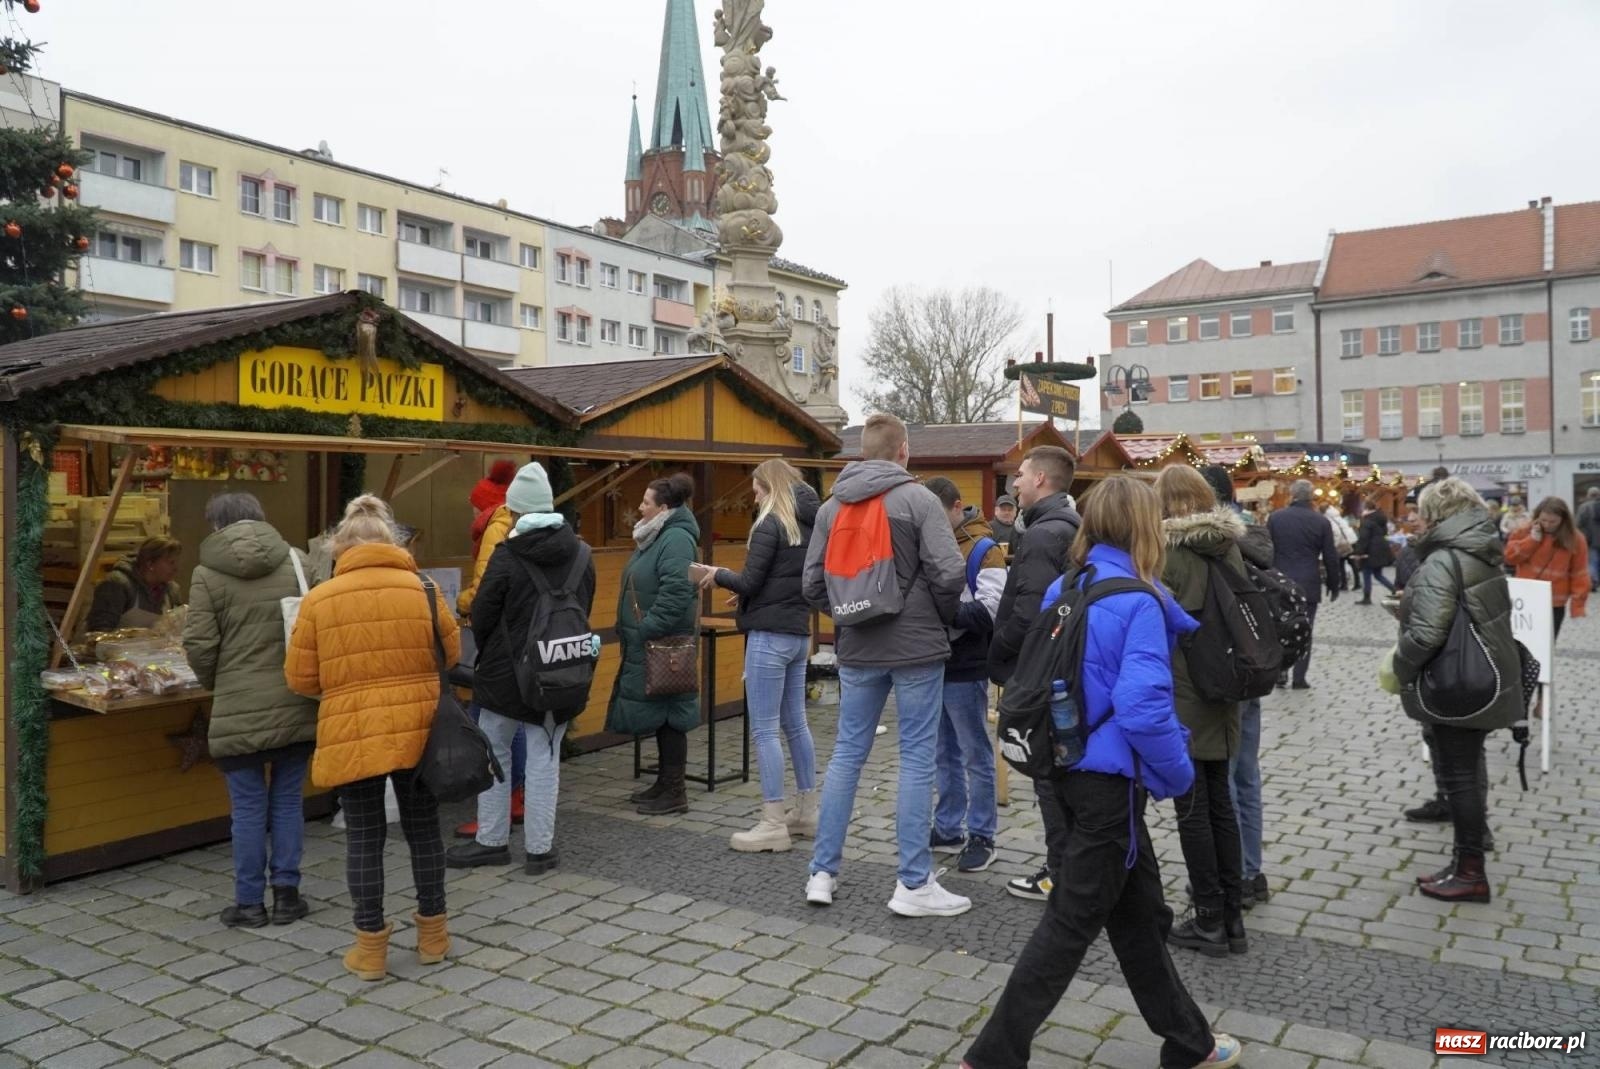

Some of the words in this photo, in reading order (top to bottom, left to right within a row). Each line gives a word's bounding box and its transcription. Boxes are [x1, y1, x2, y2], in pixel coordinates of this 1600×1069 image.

[251, 359, 349, 404] GORĄCE
[360, 370, 435, 409] PĄCZKI
[834, 600, 872, 615] adidas
[537, 632, 592, 664] VANS
